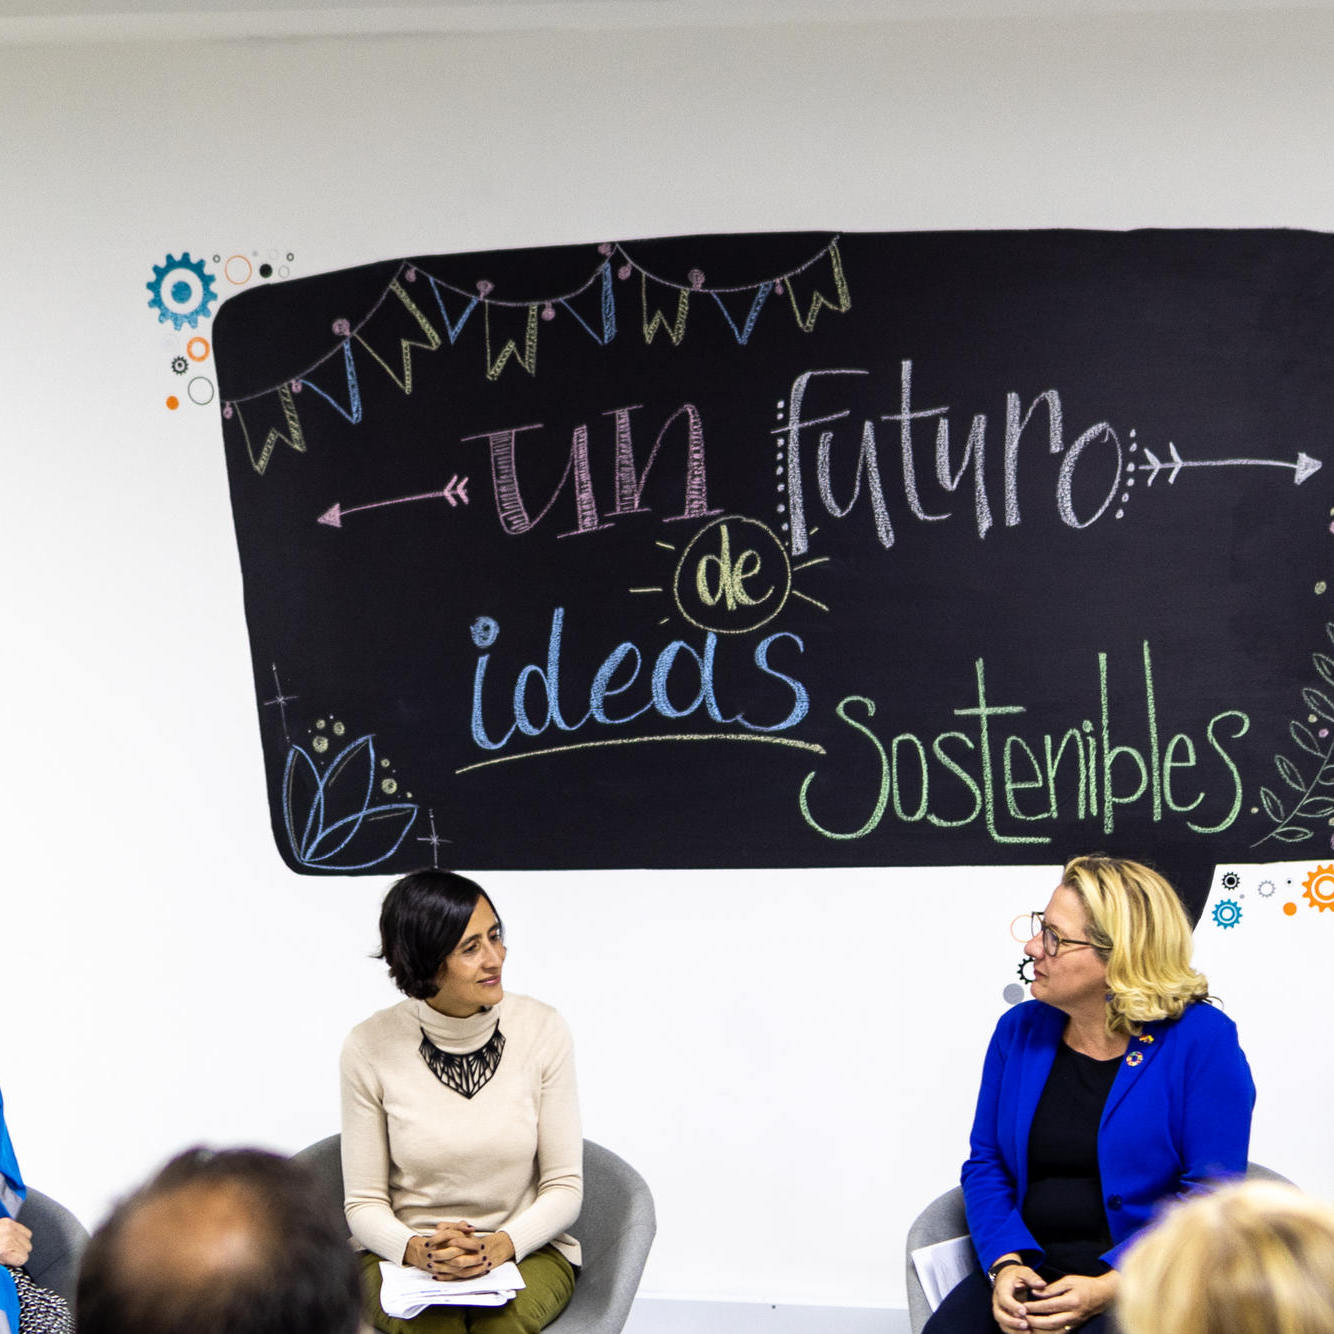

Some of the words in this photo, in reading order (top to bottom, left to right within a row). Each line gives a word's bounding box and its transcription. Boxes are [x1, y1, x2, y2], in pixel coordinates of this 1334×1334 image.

[695, 526, 776, 610] de
[470, 608, 811, 750] ideas
[798, 641, 1251, 843] Sostenibles
